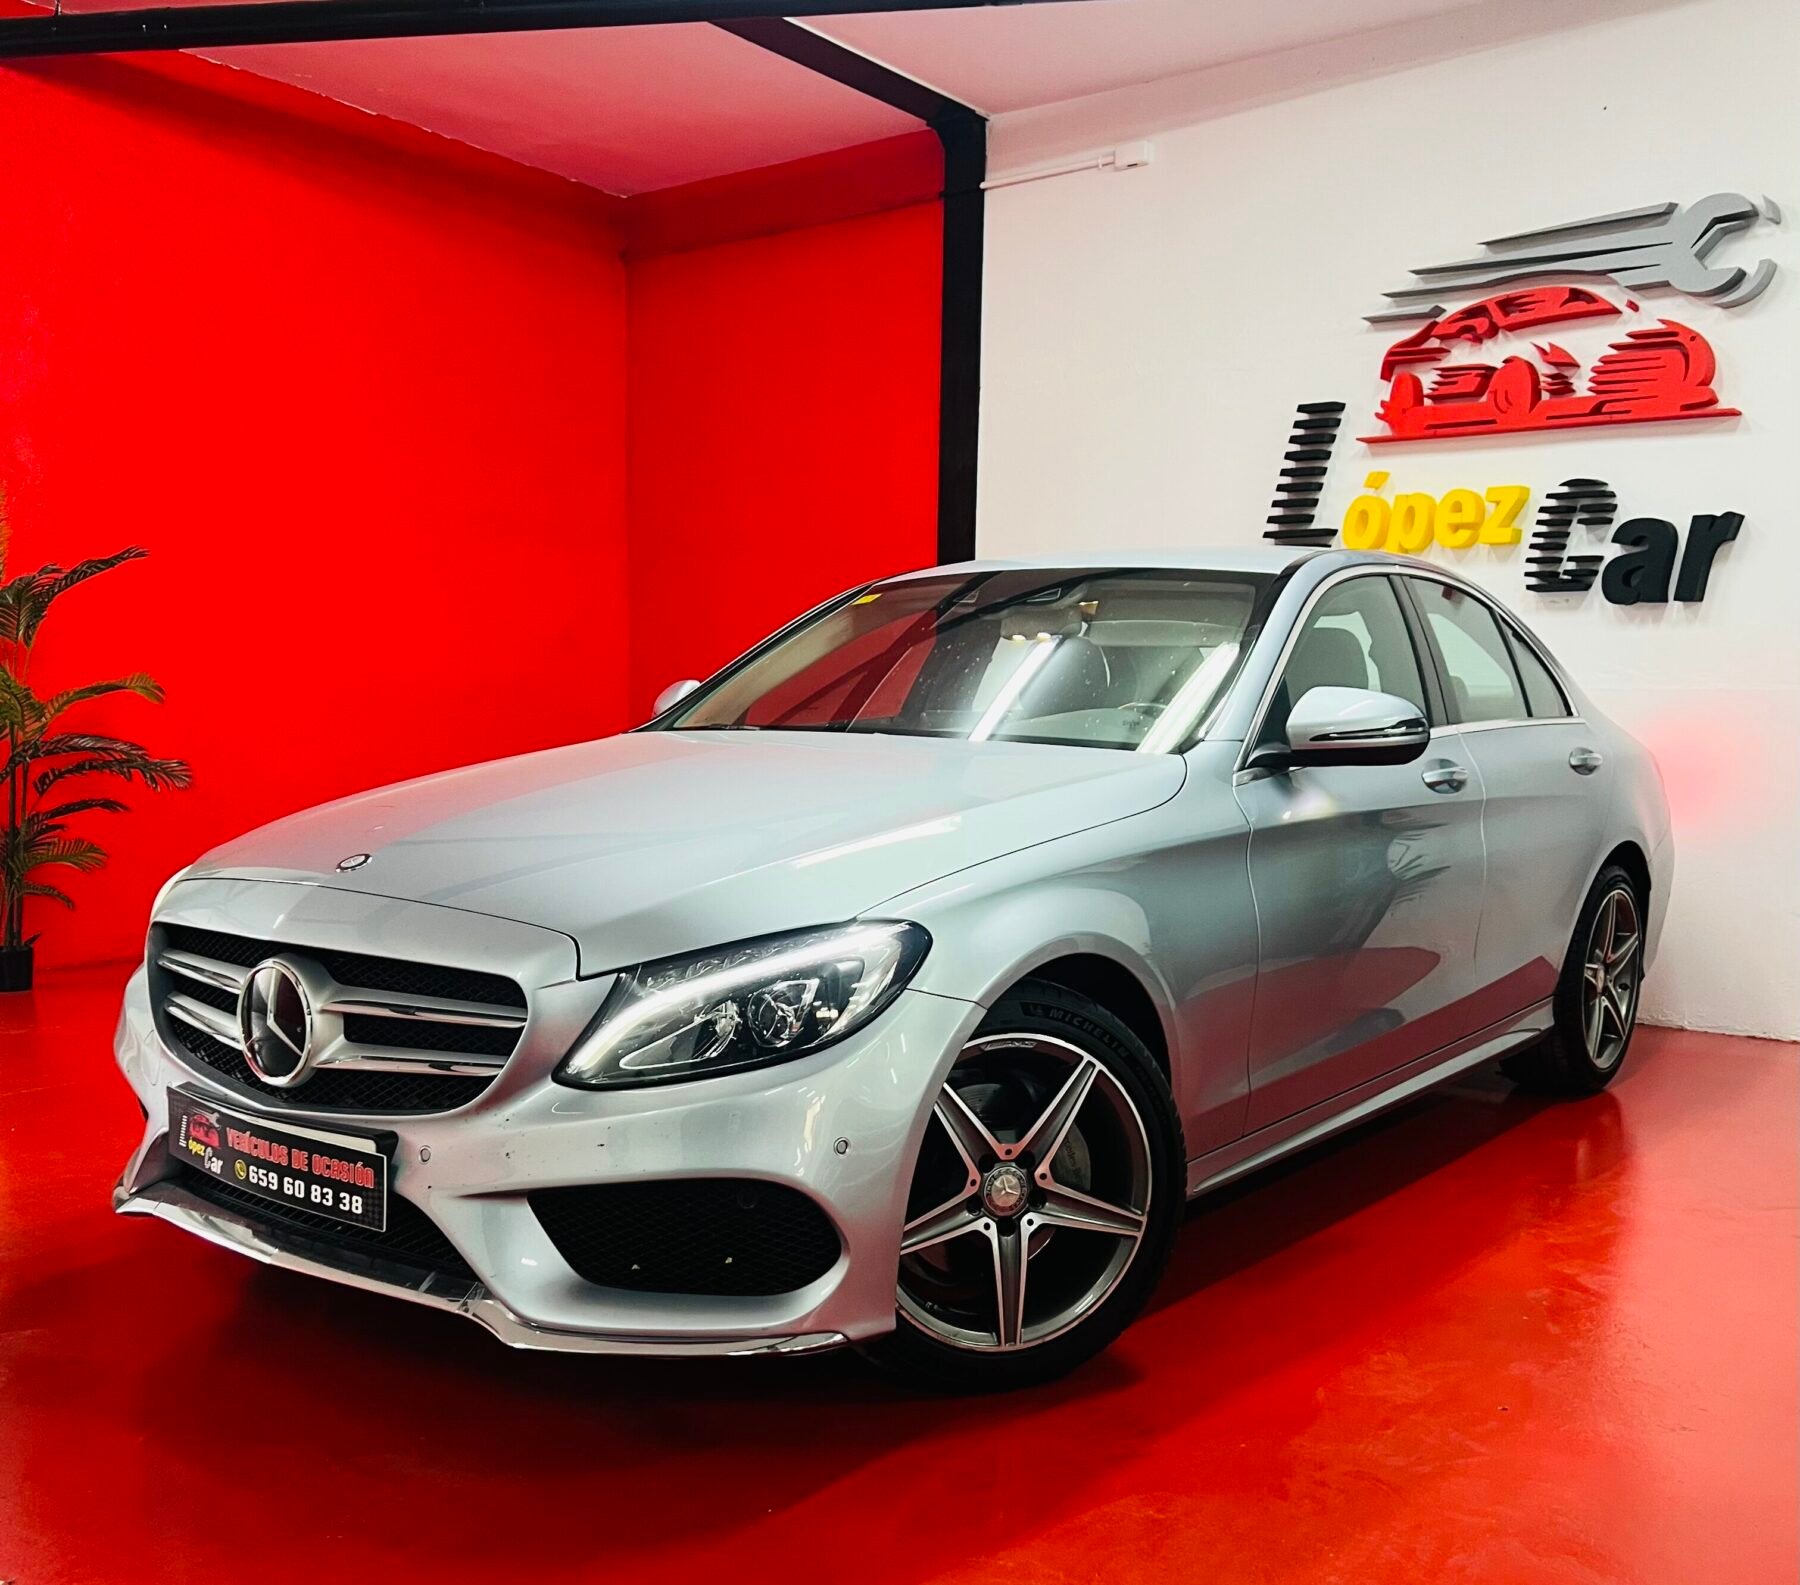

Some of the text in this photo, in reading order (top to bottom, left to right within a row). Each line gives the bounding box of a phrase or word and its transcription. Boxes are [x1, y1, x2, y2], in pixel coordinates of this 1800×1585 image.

[1262, 401, 1745, 605] López Car
[1049, 1008, 1129, 1058] MICHELIN
[204, 1147, 223, 1174] Car
[291, 1149, 309, 1172] DE
[248, 1165, 363, 1214] 659 60 83 38
